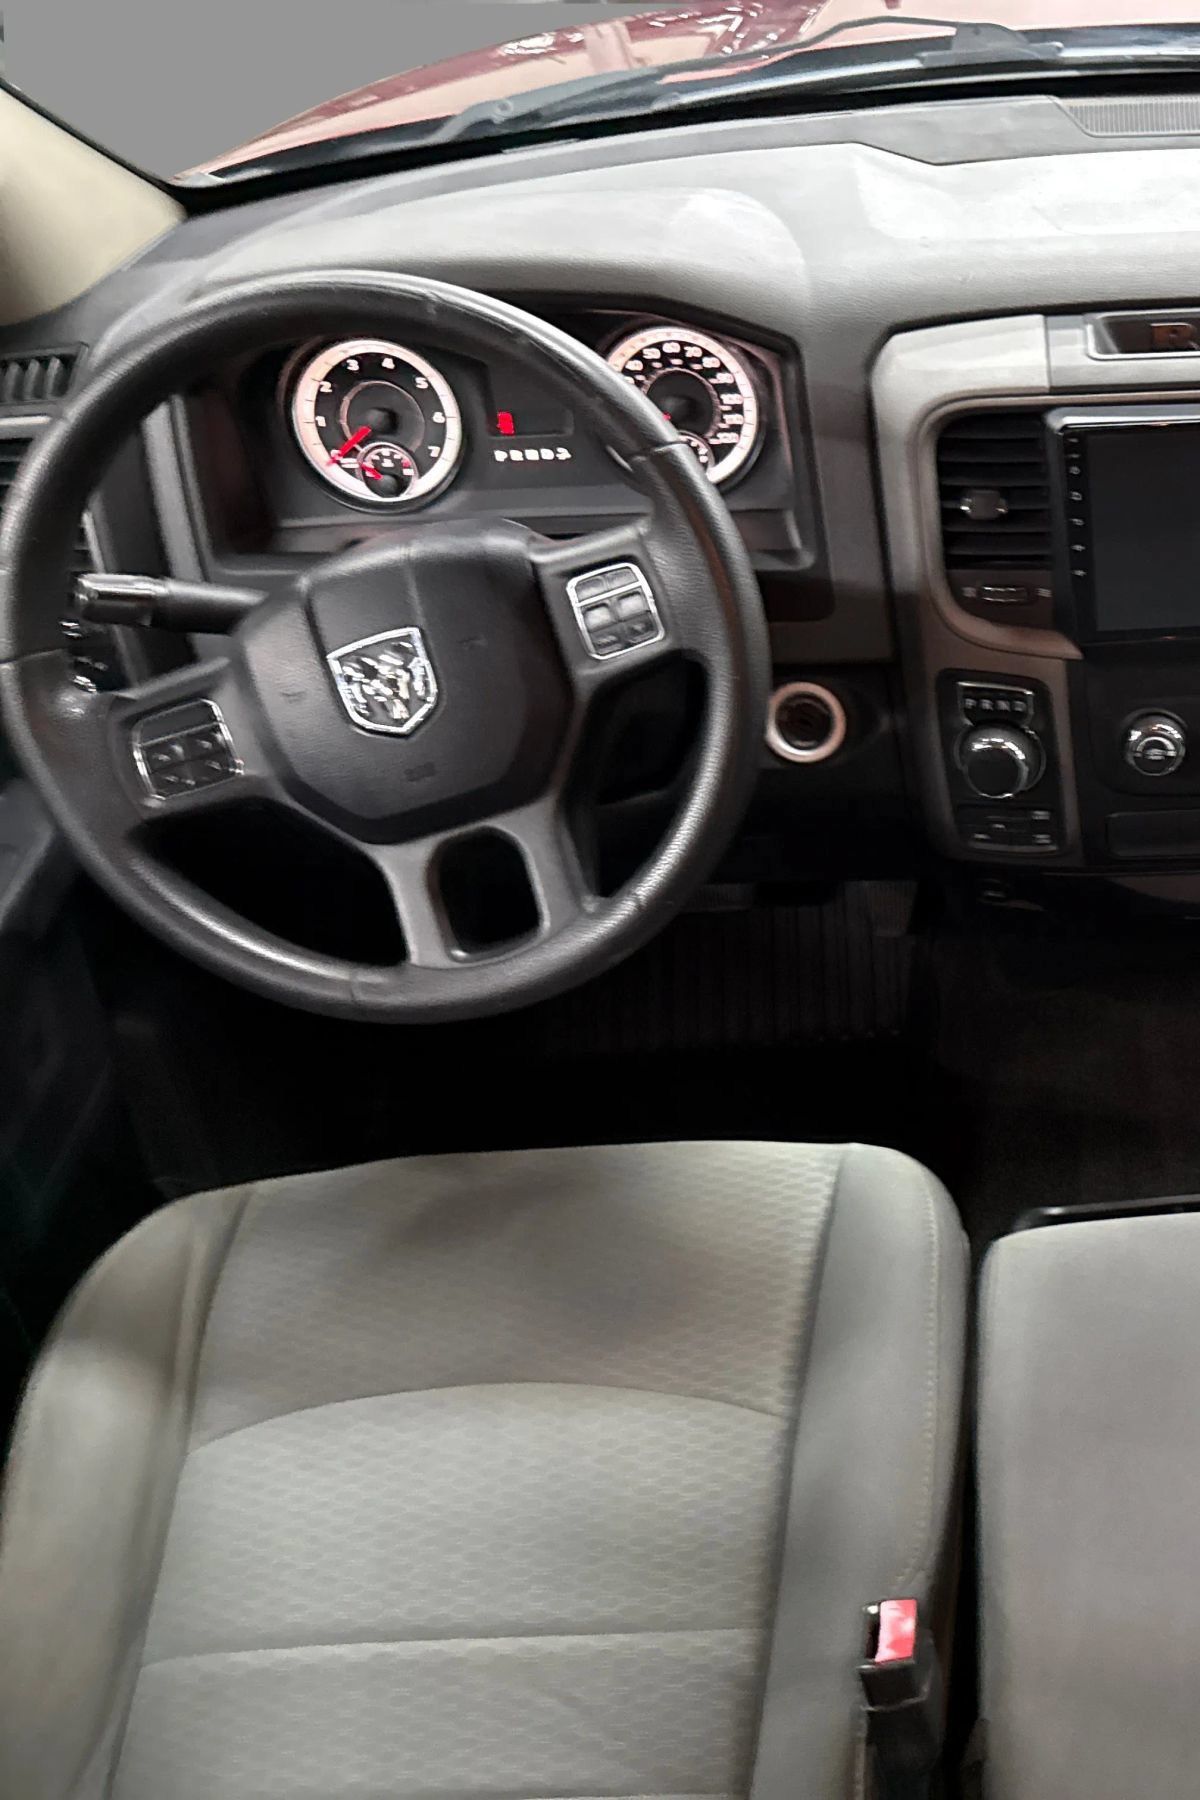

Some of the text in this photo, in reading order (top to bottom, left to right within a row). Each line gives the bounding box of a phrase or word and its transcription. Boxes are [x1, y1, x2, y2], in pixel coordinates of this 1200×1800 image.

[346, 358, 360, 371] 3
[381, 357, 395, 370] 4
[319, 381, 333, 393] 2
[415, 376, 429, 389] 5
[315, 415, 327, 428] 1
[432, 411, 446, 425] 6
[427, 446, 441, 458] 7
